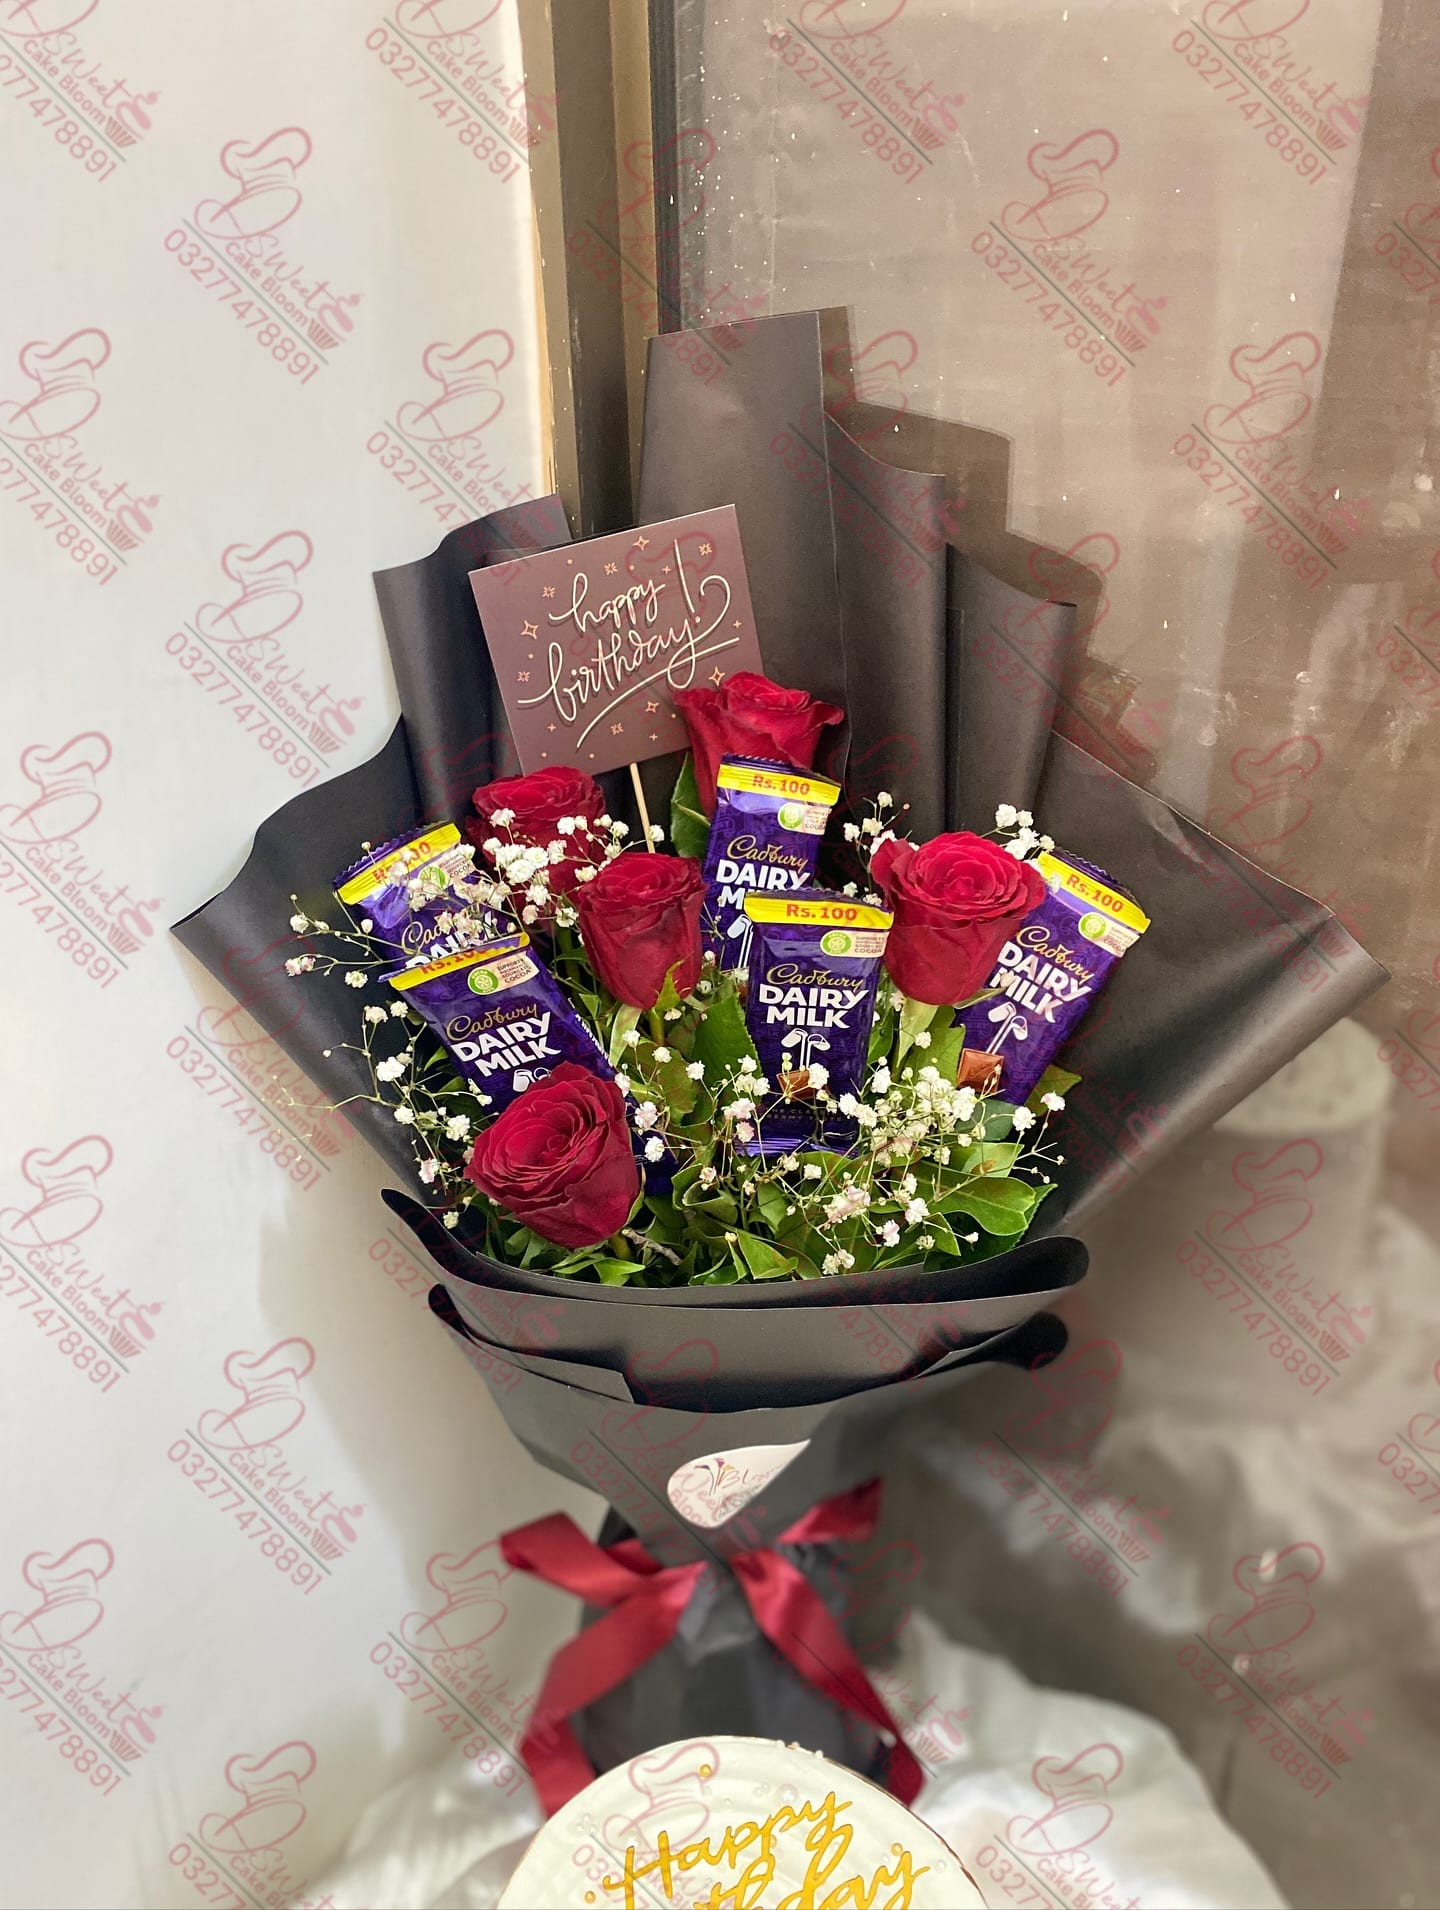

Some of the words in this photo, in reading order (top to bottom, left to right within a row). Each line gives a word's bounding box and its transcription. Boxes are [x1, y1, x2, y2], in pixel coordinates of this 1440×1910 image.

[549, 572, 666, 632] happy
[752, 773, 810, 795] Rs.100
[726, 834, 809, 873] Cadbury
[716, 859, 811, 891] DAIRY
[1067, 873, 1123, 913] Rs.100
[786, 903, 858, 921] Rs.100
[997, 940, 1092, 1002] DAIRY
[1016, 925, 1095, 984] Cadbury
[505, 969, 531, 984] COCOA
[766, 963, 864, 993] Cadbury
[989, 967, 1063, 1024] MILK
[759, 983, 869, 1010] DAIRY
[446, 1003, 537, 1041] Cadbury
[450, 1011, 551, 1062] DAIRY
[766, 1005, 850, 1029] MILK
[474, 1036, 562, 1078] MILK
[602, 1791, 853, 1910] Happy
